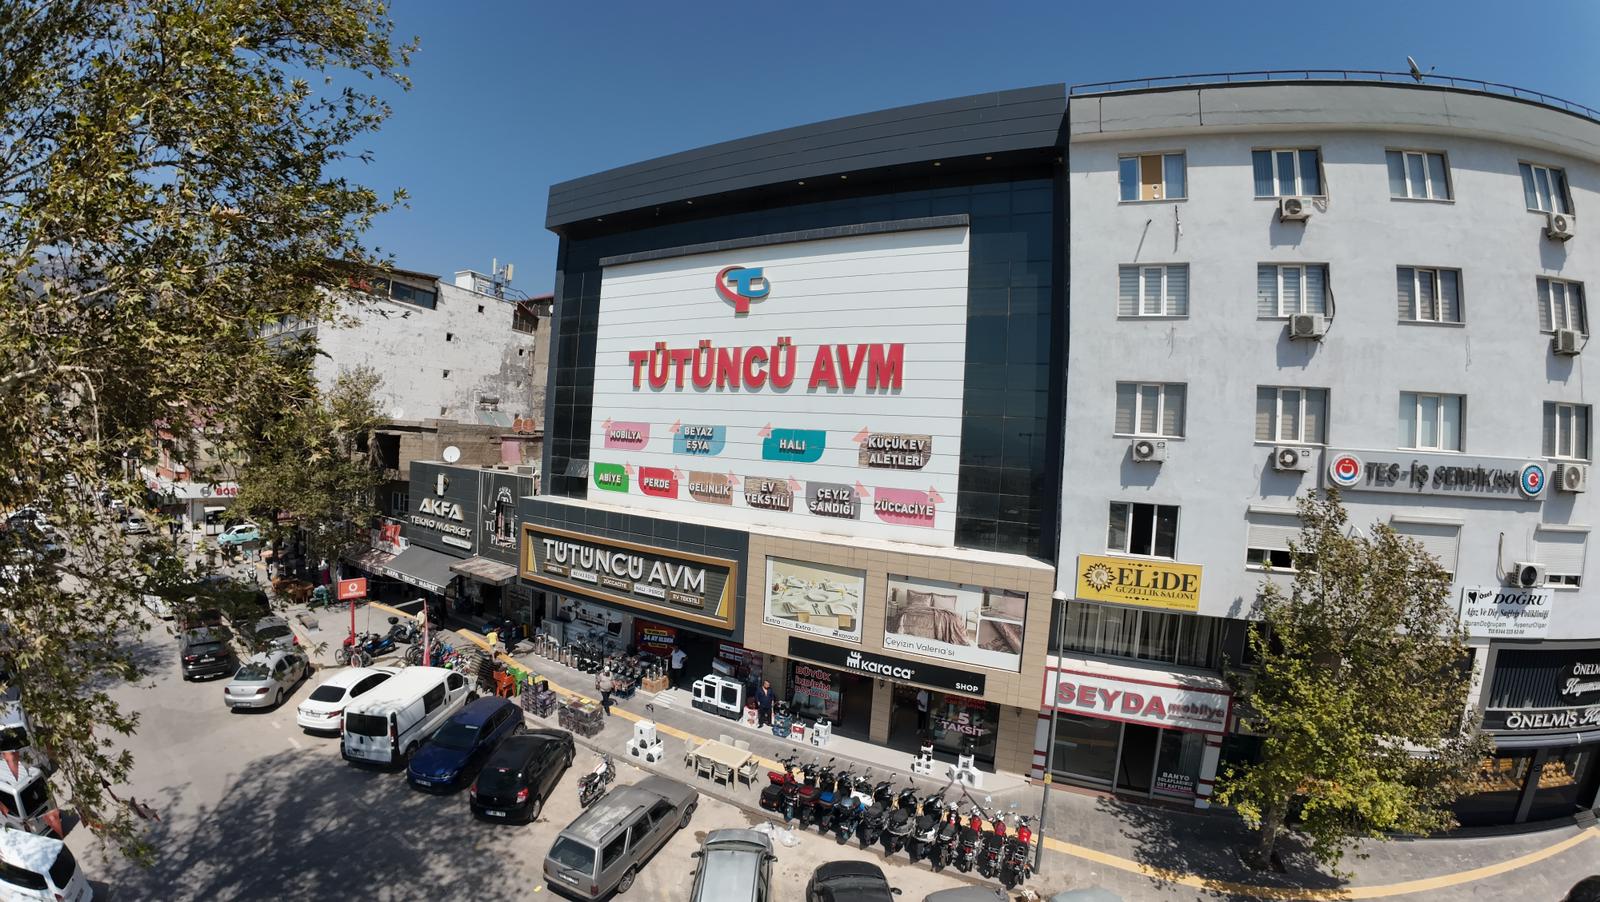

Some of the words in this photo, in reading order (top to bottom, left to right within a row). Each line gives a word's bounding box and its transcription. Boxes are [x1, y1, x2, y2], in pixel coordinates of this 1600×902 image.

[629, 337, 797, 390] TÜTÜNCÜ
[807, 343, 905, 391] AVM
[609, 428, 642, 442] MOBİLYA
[683, 426, 713, 438] BEYAZ
[686, 440, 709, 453] EŞYA
[779, 439, 806, 450] HALI
[868, 435, 907, 450] KÜÇÜK
[909, 440, 925, 450] EV
[869, 453, 924, 466] ALETLERİ
[598, 473, 622, 484] ABİYE
[643, 477, 670, 490] PERDE
[216, 487, 239, 496] BOS
[688, 482, 731, 496] GELİNLİK
[760, 482, 775, 493] EV
[816, 487, 849, 501] ÇEYİZ
[744, 493, 790, 508] TEKSTİLİ
[809, 500, 855, 515] SANDIĞI
[419, 498, 464, 521] AKFA
[874, 500, 934, 516] ZÜCCACİYE
[410, 515, 435, 528] TEKNO
[436, 521, 472, 537] MARKET
[543, 538, 643, 579] TÜTÜNCÜ
[648, 561, 706, 593] AVM
[386, 569, 399, 578] AKFA
[1493, 592, 1548, 605] DOĞRU
[765, 616, 781, 624] Extra
[795, 622, 811, 631] Extra
[860, 659, 912, 680] karaca
[955, 682, 979, 692] SHOP
[1057, 682, 1166, 717] SEYDA
[958, 712, 969, 724] 5
[1506, 709, 1578, 728] ÖNELMİŞ
[941, 721, 985, 736] TAKSİT
[1162, 772, 1190, 781] BANYO
